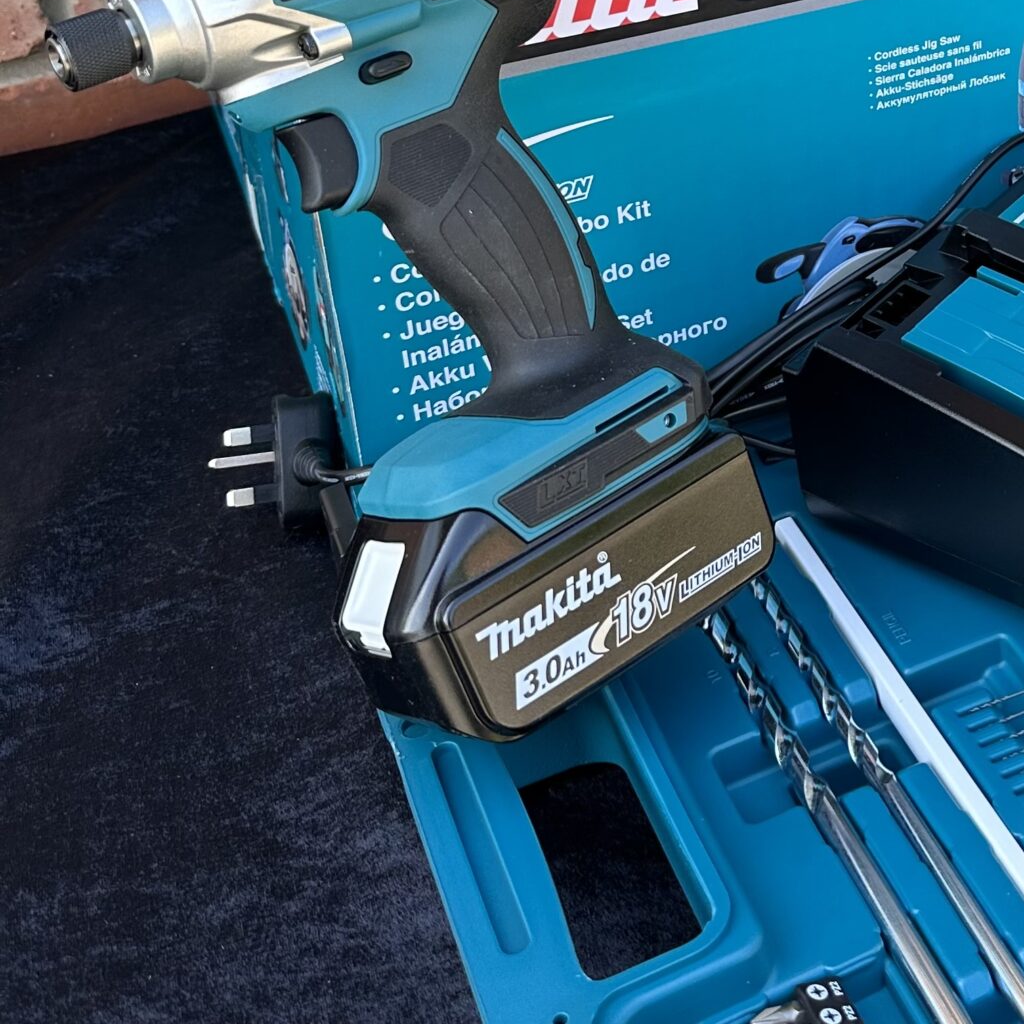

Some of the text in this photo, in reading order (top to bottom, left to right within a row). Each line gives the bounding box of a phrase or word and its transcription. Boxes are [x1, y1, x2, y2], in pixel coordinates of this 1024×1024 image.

[874, 34, 961, 62] Cordless Jig Saw
[874, 63, 897, 74] Scie
[899, 51, 945, 67] sauteuse
[946, 46, 970, 57] sans
[875, 73, 905, 86] Sierra
[907, 62, 952, 78] Caladora
[876, 72, 1006, 111] Аккумуляторный Лобзик
[617, 200, 651, 224] Kit
[640, 252, 671, 273] de
[409, 362, 475, 395] Akku
[523, 532, 762, 699] 3.0Ah 18V LITHIUM-ION
